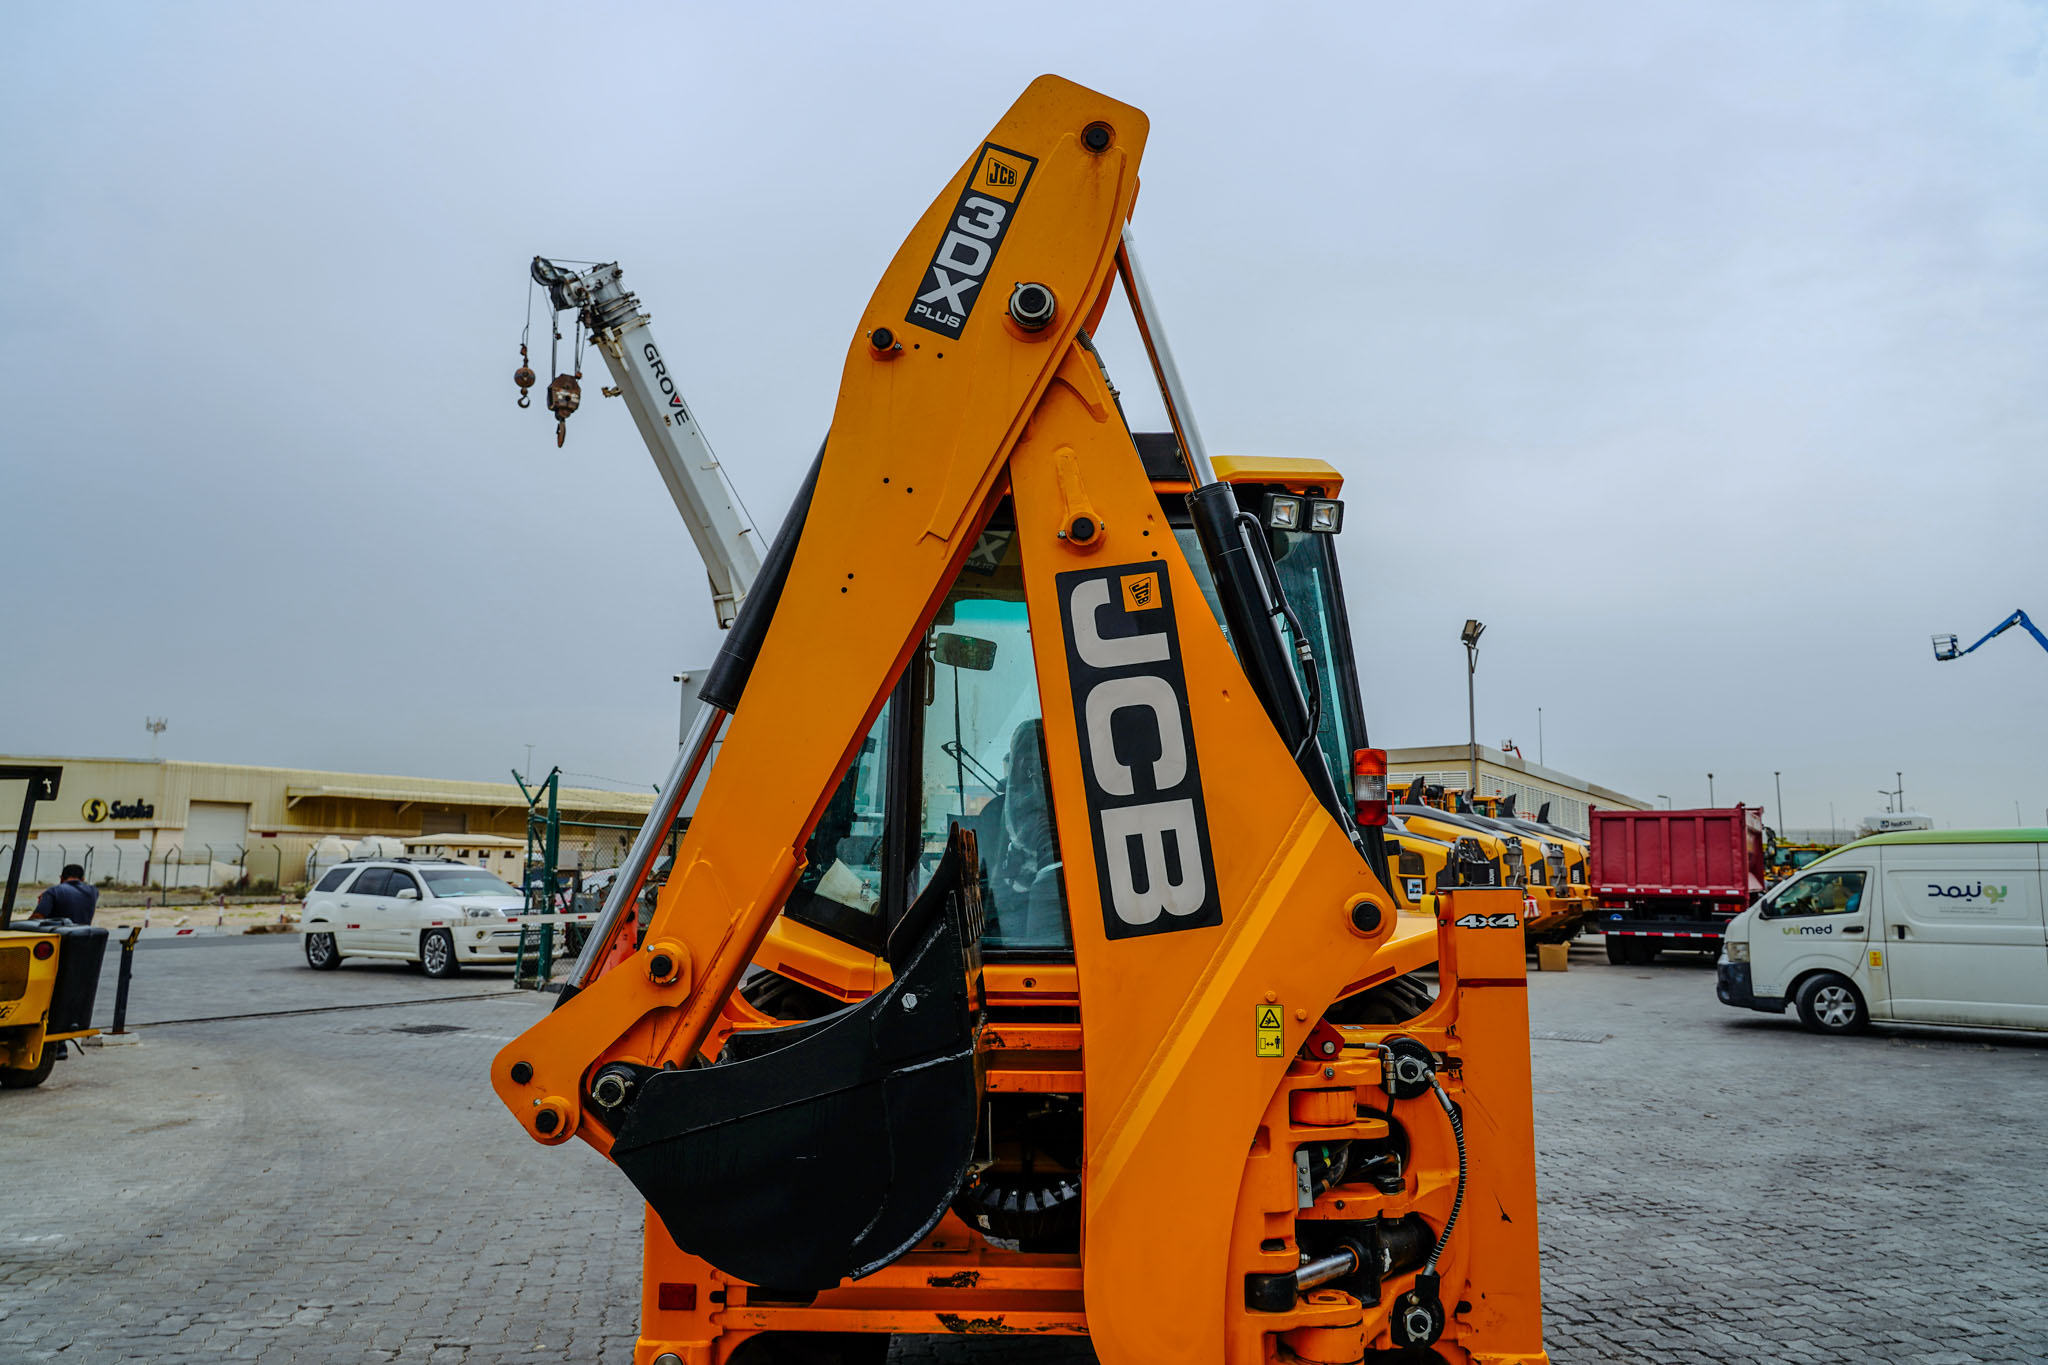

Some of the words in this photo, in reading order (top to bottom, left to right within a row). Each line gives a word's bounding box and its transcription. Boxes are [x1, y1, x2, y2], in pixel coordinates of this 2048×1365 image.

[989, 162, 1016, 186] JCB
[916, 196, 1007, 317] 3DX
[913, 303, 961, 329] PLUS
[643, 343, 690, 426] GROVE
[1130, 581, 1150, 605] JCB
[1069, 577, 1207, 926] JCB
[1782, 923, 1833, 935] unimed
